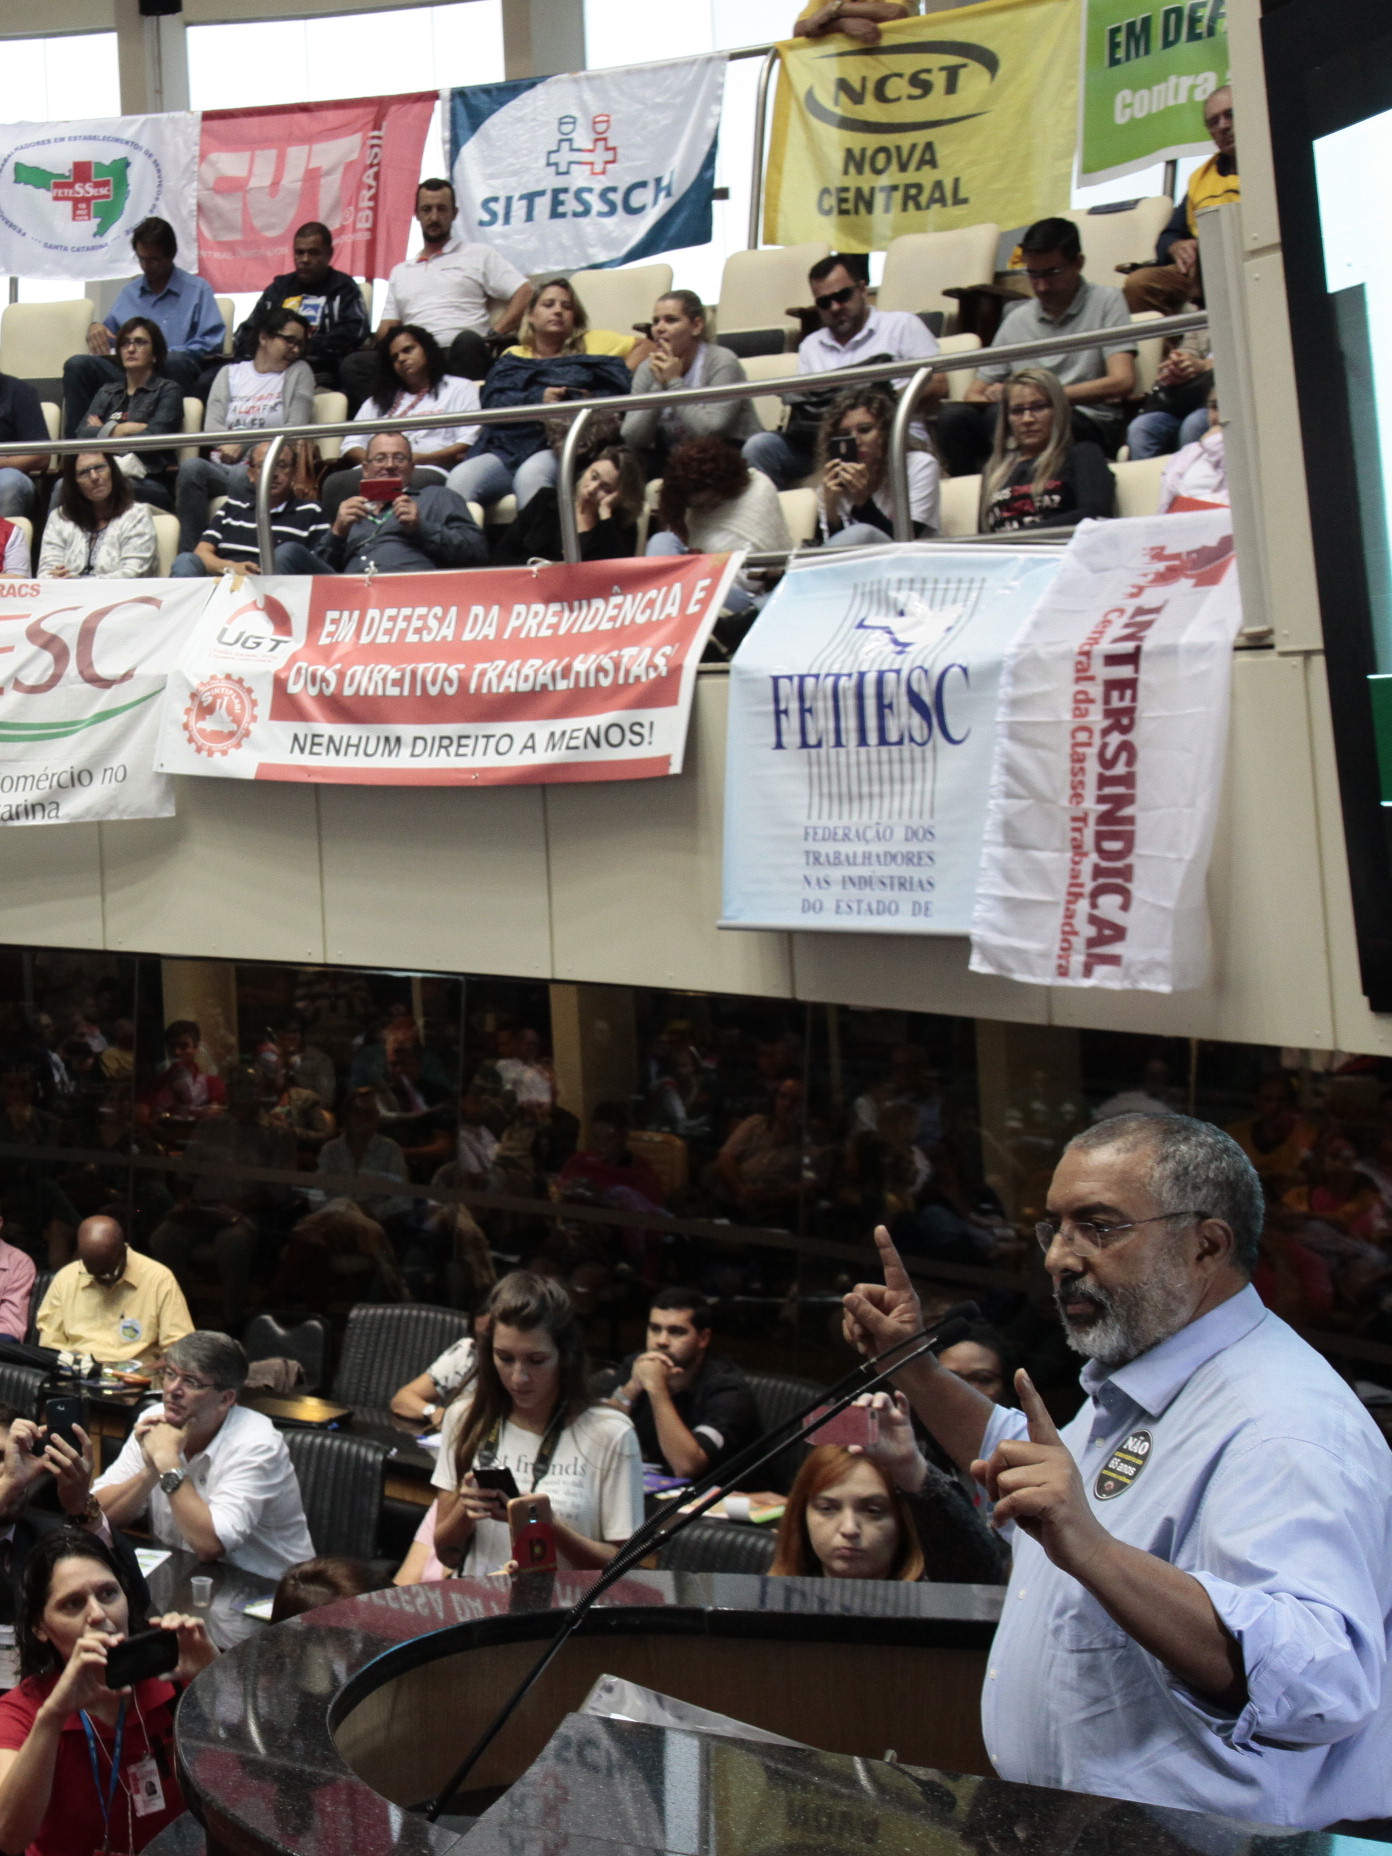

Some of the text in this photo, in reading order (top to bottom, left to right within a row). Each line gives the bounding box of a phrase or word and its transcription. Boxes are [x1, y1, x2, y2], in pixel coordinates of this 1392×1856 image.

[1107, 0, 1227, 68] EM DEF
[834, 63, 969, 107] NCST
[1114, 71, 1217, 125] Contra
[356, 122, 387, 229] BRASIL
[843, 141, 938, 176] NOVA
[197, 132, 362, 241] CUT
[477, 170, 676, 227] SITESSCH
[818, 177, 969, 217] CENTRAL
[318, 578, 712, 645] EM DEFESA DA PREVIDÊNCIA E
[217, 626, 292, 652] UGT
[1074, 607, 1126, 685] Central
[287, 642, 680, 697] DOS DIREITOS TRABALHISTAS
[769, 662, 972, 750] FETIESC
[1072, 689, 1096, 719] da
[290, 721, 655, 758] NENHUM DIREITO A MENOS!
[100, 763, 128, 787] no
[1083, 600, 1169, 978] INTERSINDICAL
[803, 821, 936, 846] FEDERAÇÃO DOS
[804, 850, 936, 867] TRABALHADORES
[803, 870, 936, 893] NAS INDÚSTRIAS
[1056, 811, 1089, 978] Trabalhadora
[801, 898, 934, 918] DO ESTADO DE
[516, 1453, 587, 1477] frnds
[1122, 1435, 1150, 1456] NÃO
[1116, 1461, 1137, 1477] anos
